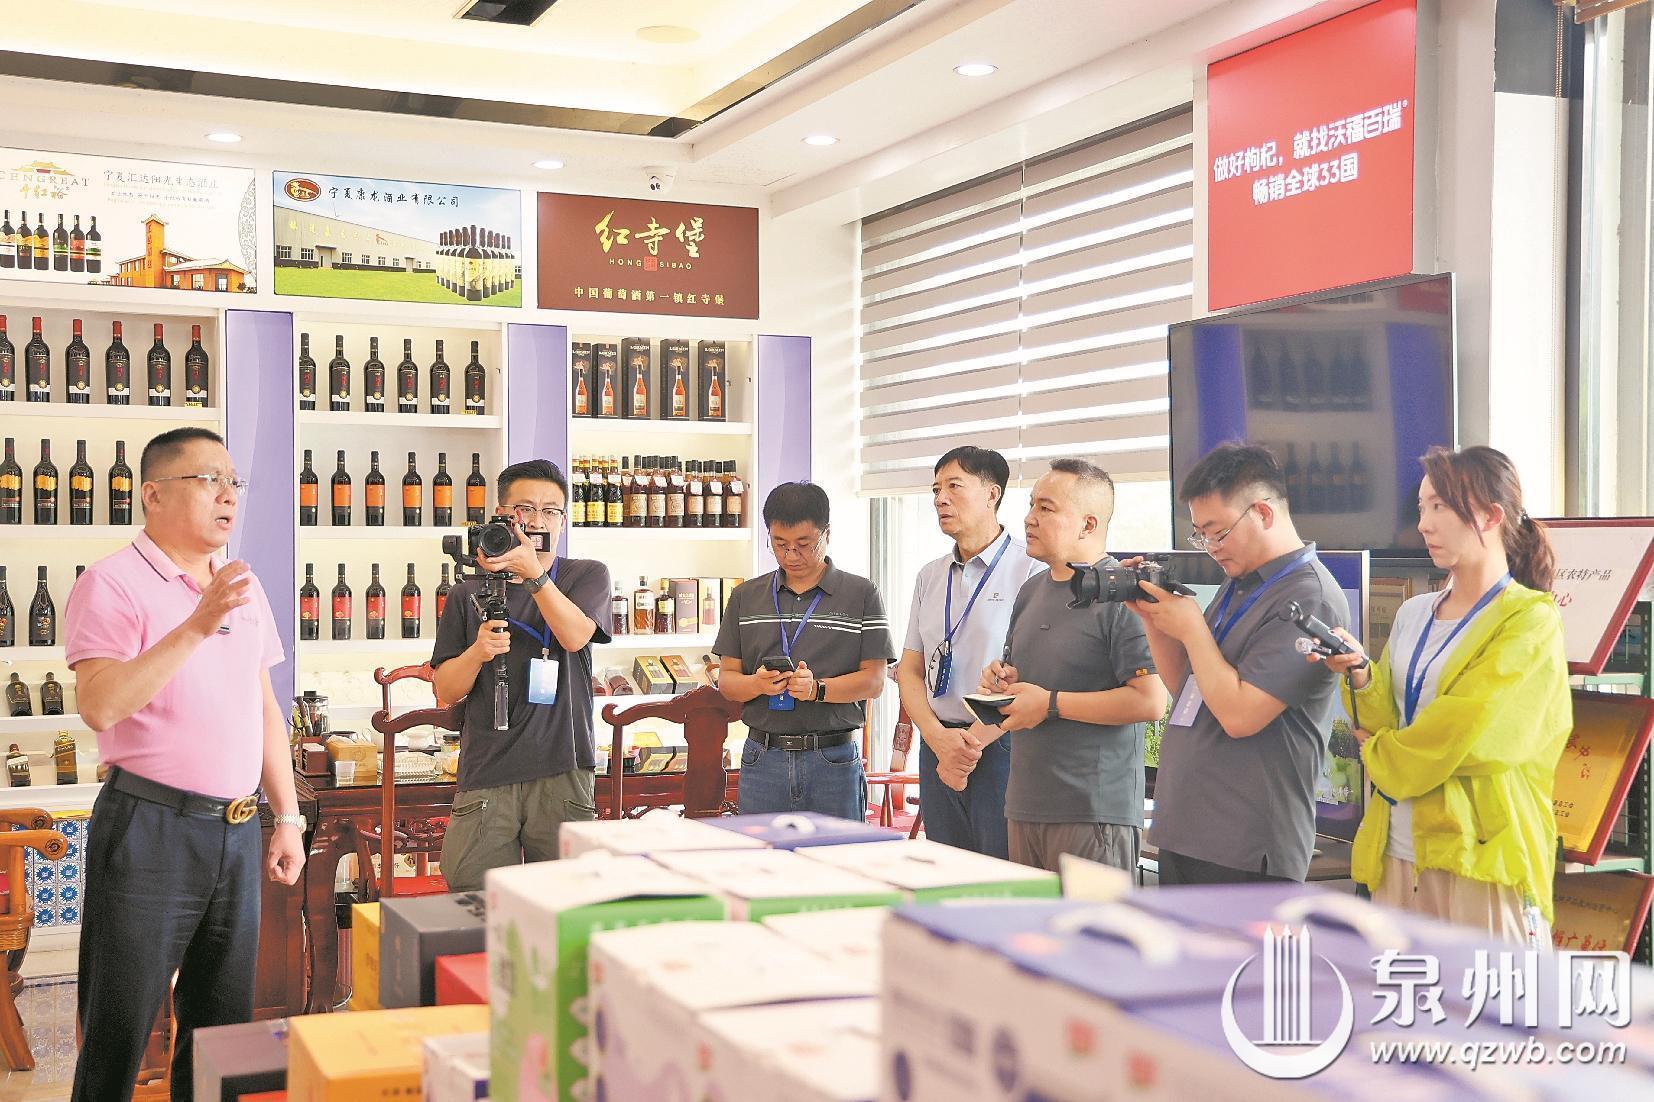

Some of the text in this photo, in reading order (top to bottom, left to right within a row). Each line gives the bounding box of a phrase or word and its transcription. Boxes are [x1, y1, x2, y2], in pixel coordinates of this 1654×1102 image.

[1252, 153, 1358, 205] 畅销全球33国
[328, 186, 459, 208] 宁夏康龙酒业有限公司
[594, 210, 705, 258] 红寺堡
[609, 257, 642, 267] HONG
[659, 261, 692, 270] SIBAO
[574, 286, 726, 306] 中国葡萄酒第一镇红寺堡
